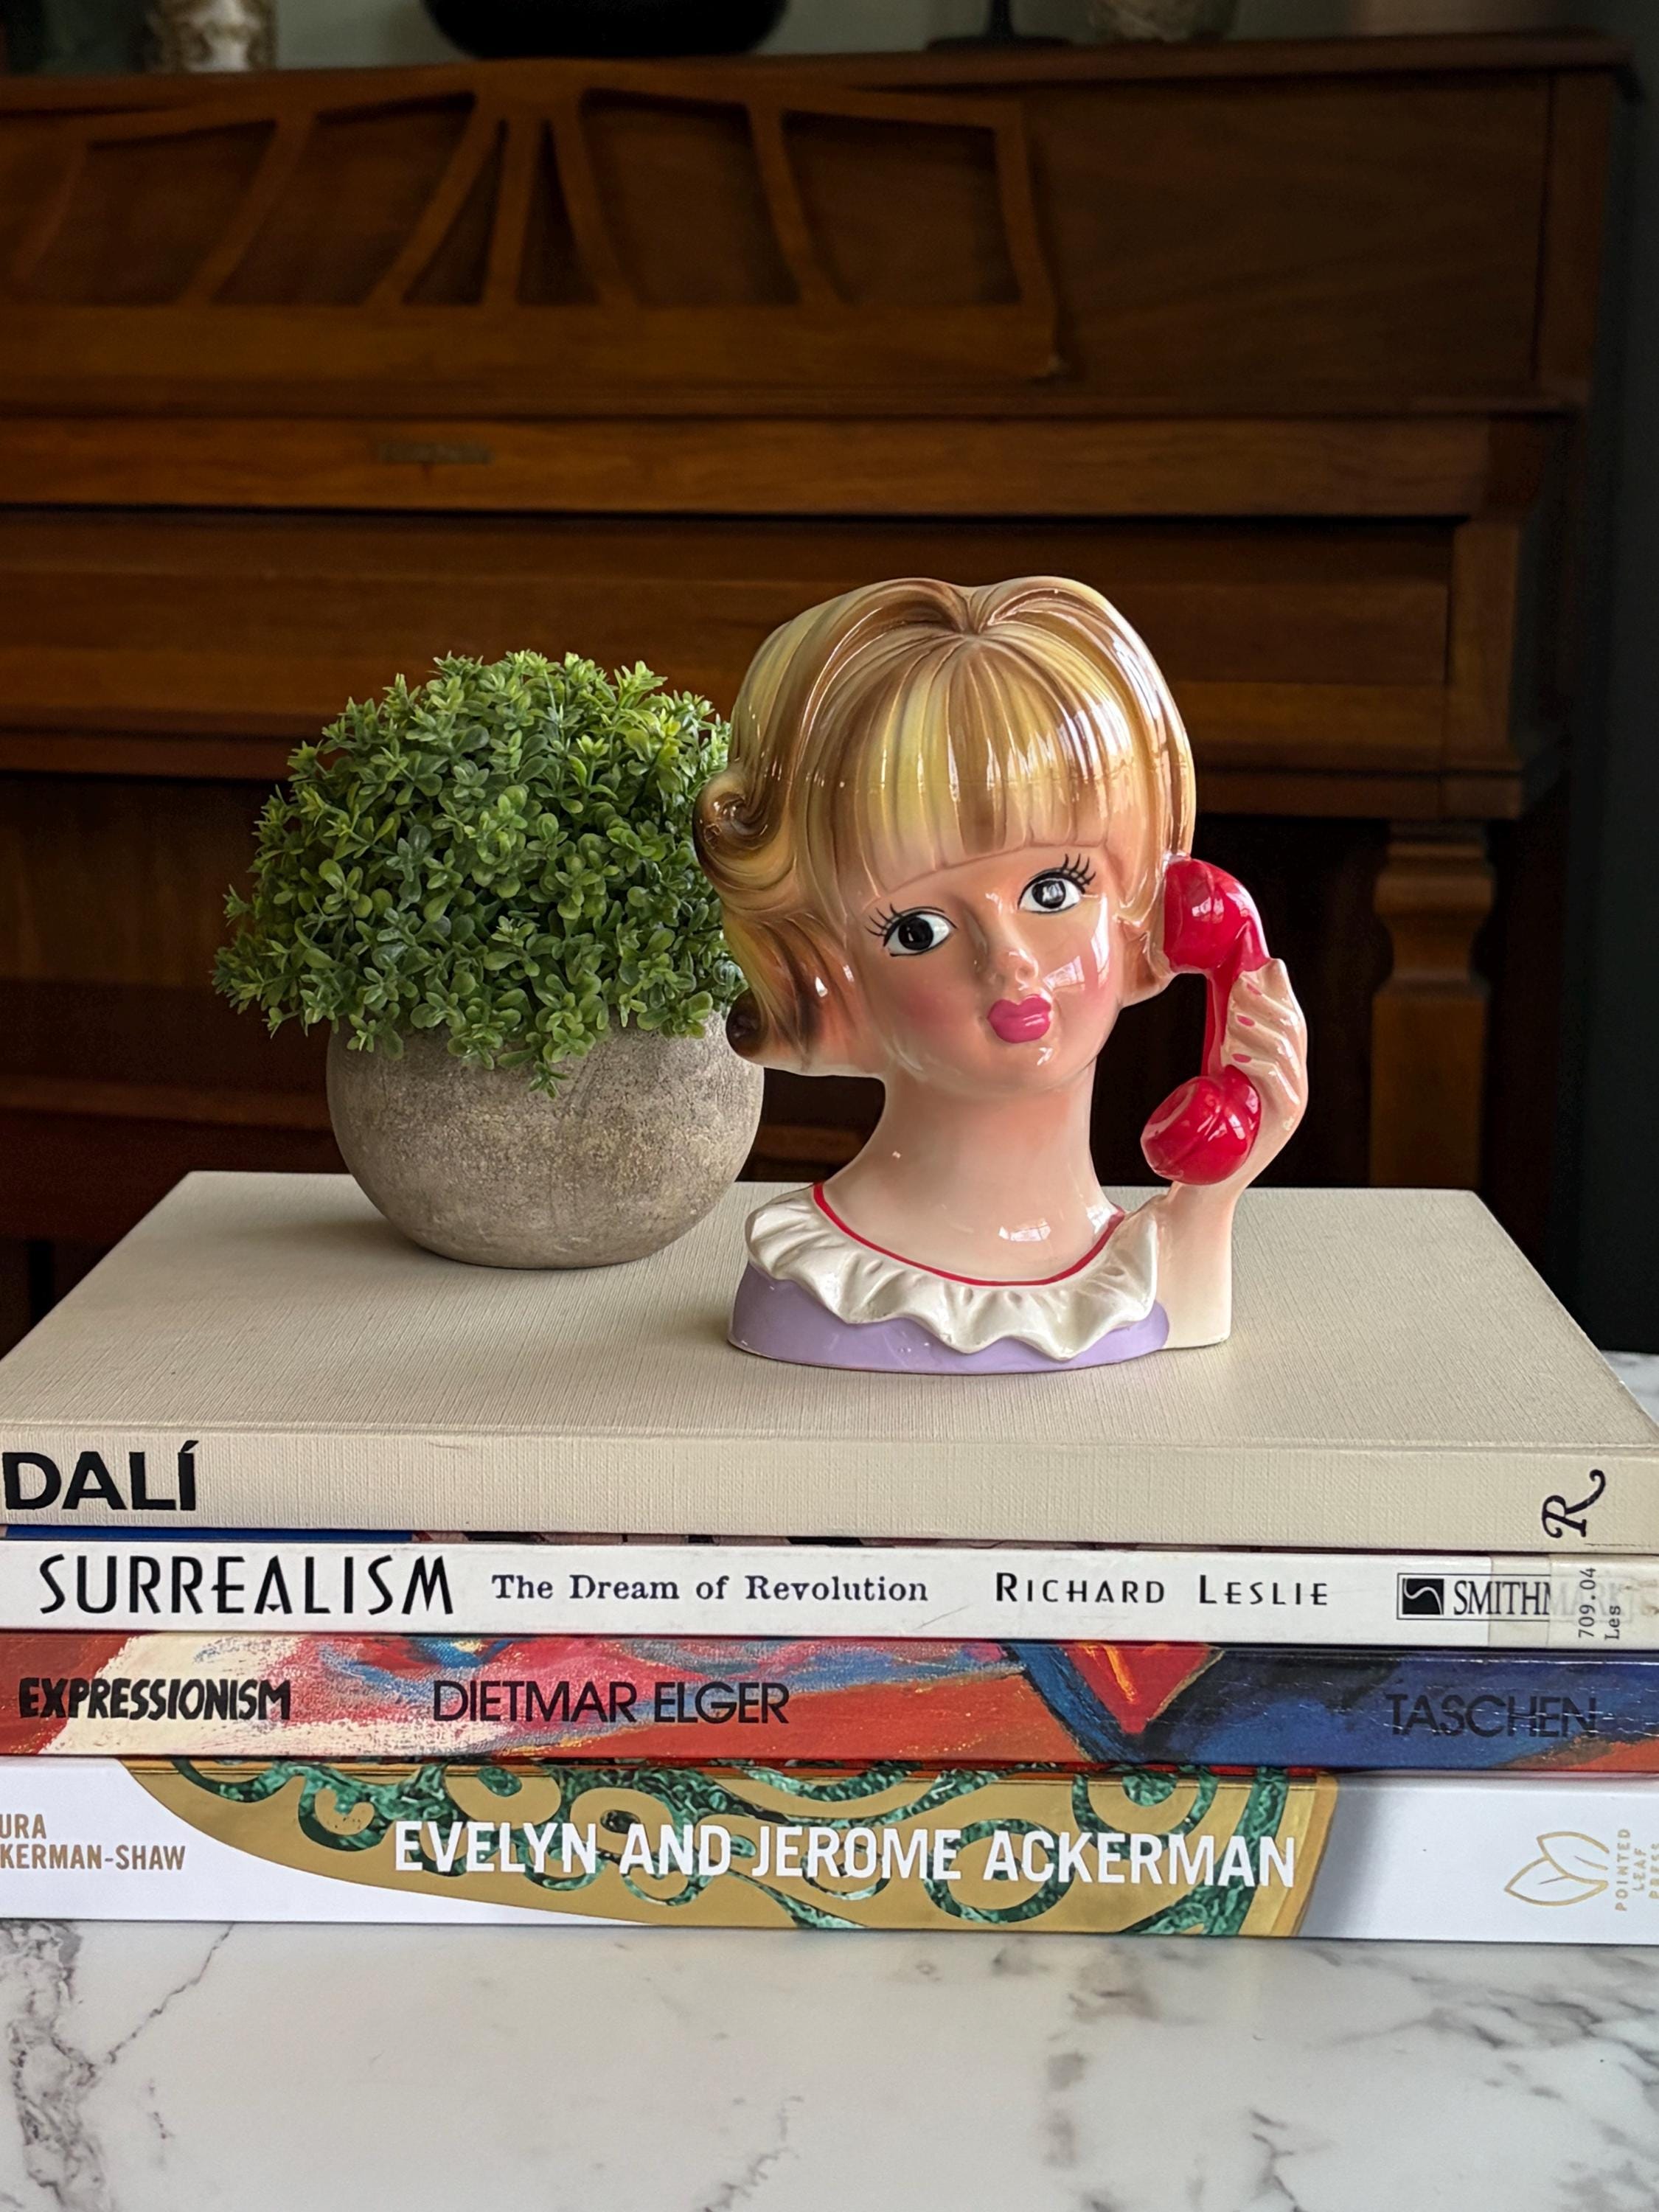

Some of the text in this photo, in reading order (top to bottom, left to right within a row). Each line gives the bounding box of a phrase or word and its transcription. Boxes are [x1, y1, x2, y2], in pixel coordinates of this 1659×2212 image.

[2, 1440, 198, 1511] DALÍ
[1541, 1469, 1606, 1538] R
[40, 1554, 453, 1615] SURREALISM
[492, 1574, 928, 1601] The Dream of Revolution
[995, 1572, 1328, 1605] RICHARD LESLIE
[1578, 1567, 1596, 1638] 709.04
[1604, 1604, 1621, 1641] Les
[19, 1677, 291, 1720] EXPRESSIONISM
[434, 1680, 790, 1724] DIETMAR ELGER
[1386, 1694, 1596, 1738] TASCHEN
[394, 1820, 1294, 1888] EVELYN AND JEROME ACKERMAN
[1615, 1829, 1630, 1911] POINTED
[1632, 1848, 1646, 1891] LEAF
